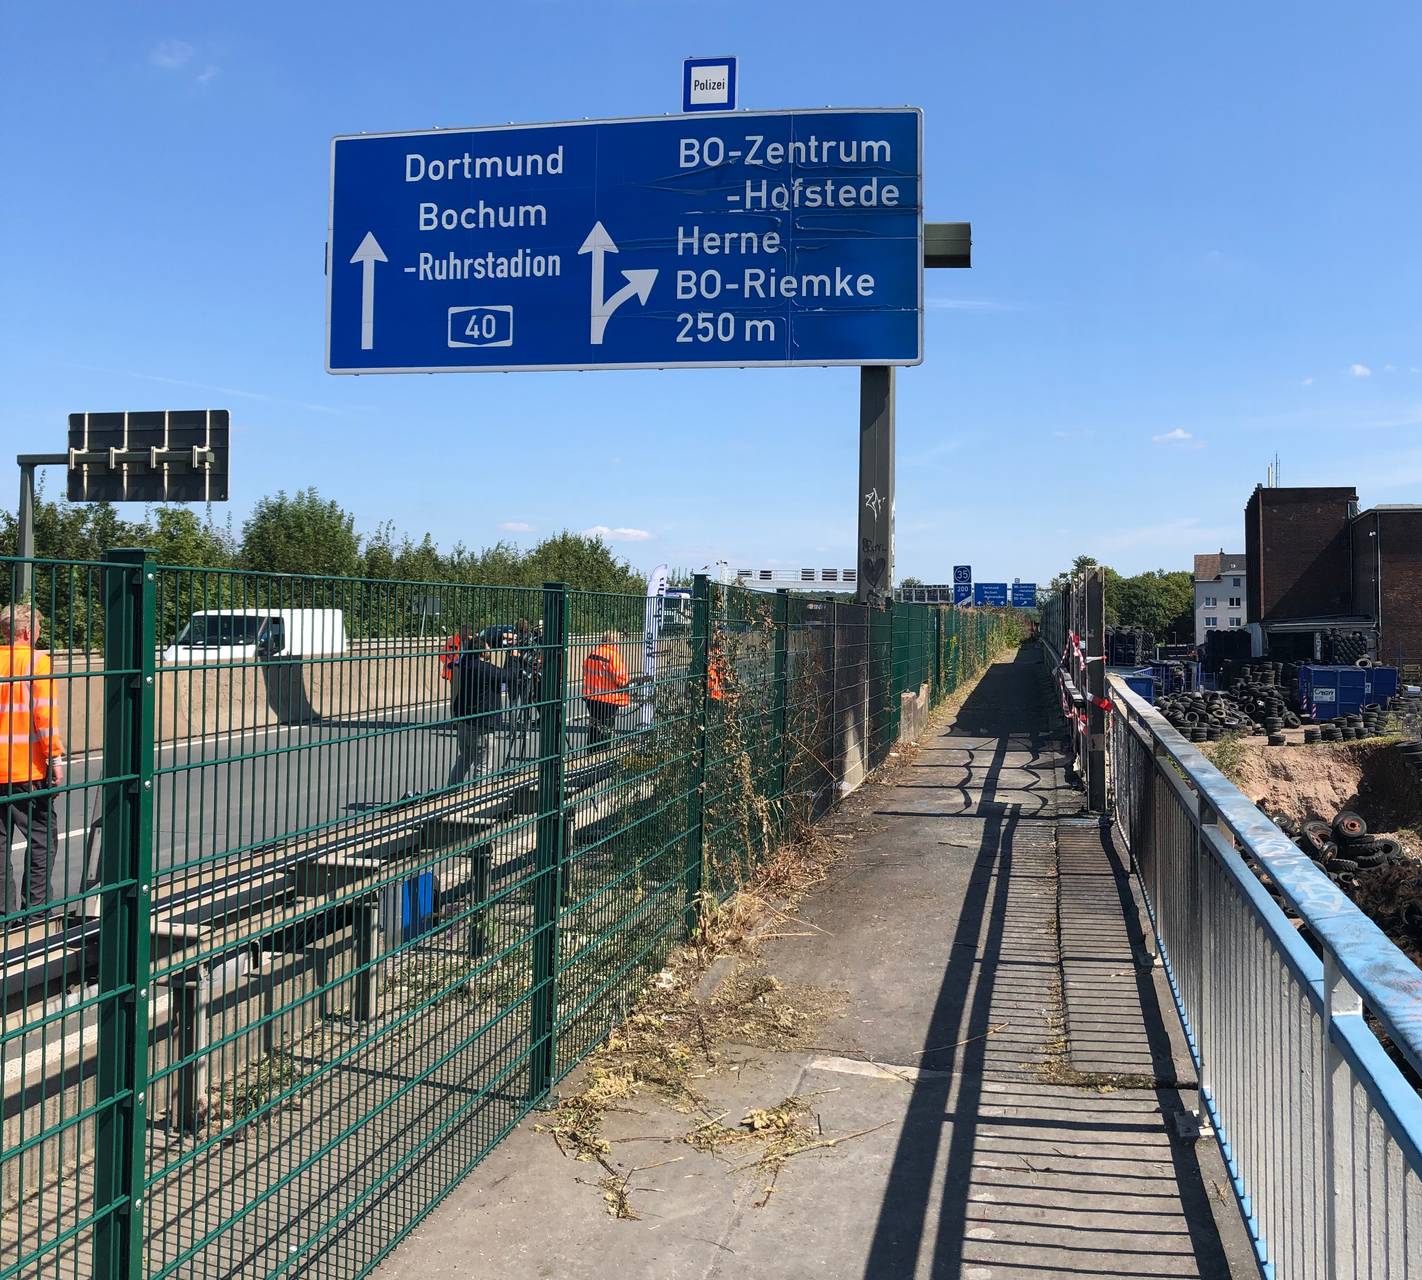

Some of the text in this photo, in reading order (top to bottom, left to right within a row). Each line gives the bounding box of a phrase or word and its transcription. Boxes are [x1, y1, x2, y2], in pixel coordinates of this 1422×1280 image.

[694, 78, 725, 91] Polizei
[405, 145, 563, 182] Dortmund
[679, 135, 891, 168] BO-Zentrum
[727, 177, 899, 209] -Hofstede
[419, 200, 546, 231] Bochum
[677, 225, 780, 256] Herne
[404, 249, 560, 281] -Ruhrstadion
[676, 266, 875, 300] BO-Riemke
[465, 314, 496, 338] 40
[676, 312, 775, 342] 250 m
[957, 570, 968, 579] 35
